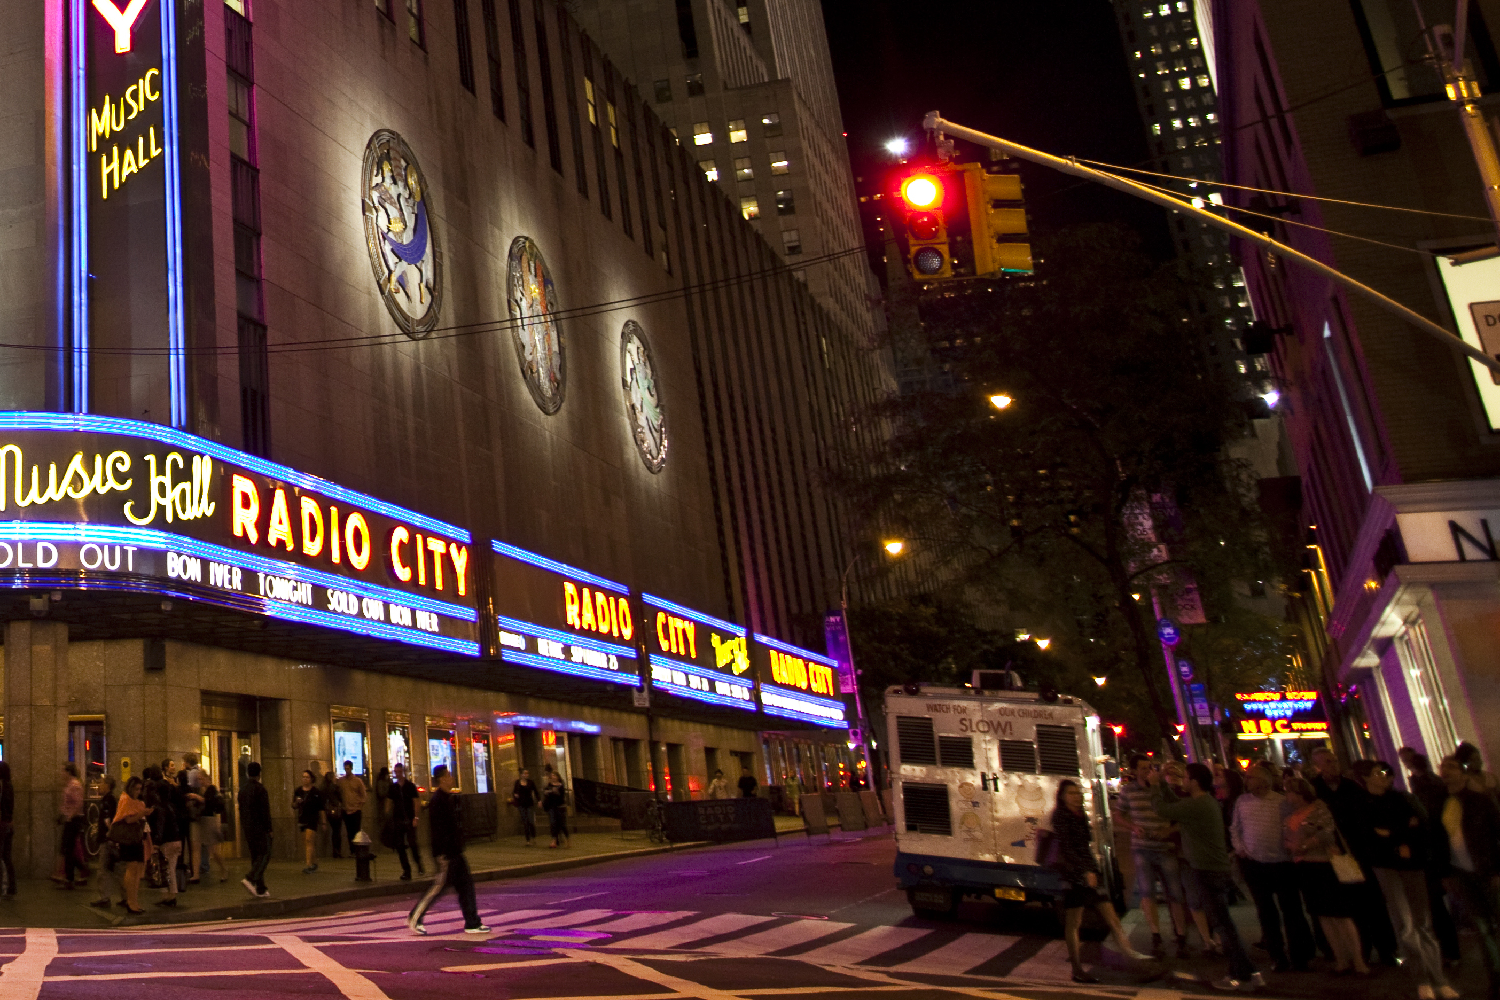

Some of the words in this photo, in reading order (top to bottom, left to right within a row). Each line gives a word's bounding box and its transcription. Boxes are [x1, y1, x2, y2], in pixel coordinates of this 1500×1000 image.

[89, 66, 161, 153] MUSIC
[100, 126, 162, 201] HALL
[123, 452, 216, 527] Hall
[230, 472, 372, 572] RADIO
[389, 524, 470, 597] CITY
[79, 543, 139, 573] OUT
[166, 550, 202, 581] BON
[208, 560, 243, 592] IVER
[257, 570, 312, 606] TONIGHT
[326, 588, 359, 616] SOLD
[362, 597, 385, 621] OUT
[563, 581, 634, 641] RADIO
[656, 611, 697, 659] CITY
[768, 649, 808, 690] RADIO
[808, 661, 835, 697] CITY
[926, 703, 951, 714] WATCH
[953, 704, 967, 714] FOR
[999, 707, 1016, 718] OUR
[1017, 708, 1054, 720] CHILDREN
[959, 717, 1014, 735] SLOW!
[1240, 719, 1292, 734] NBC
